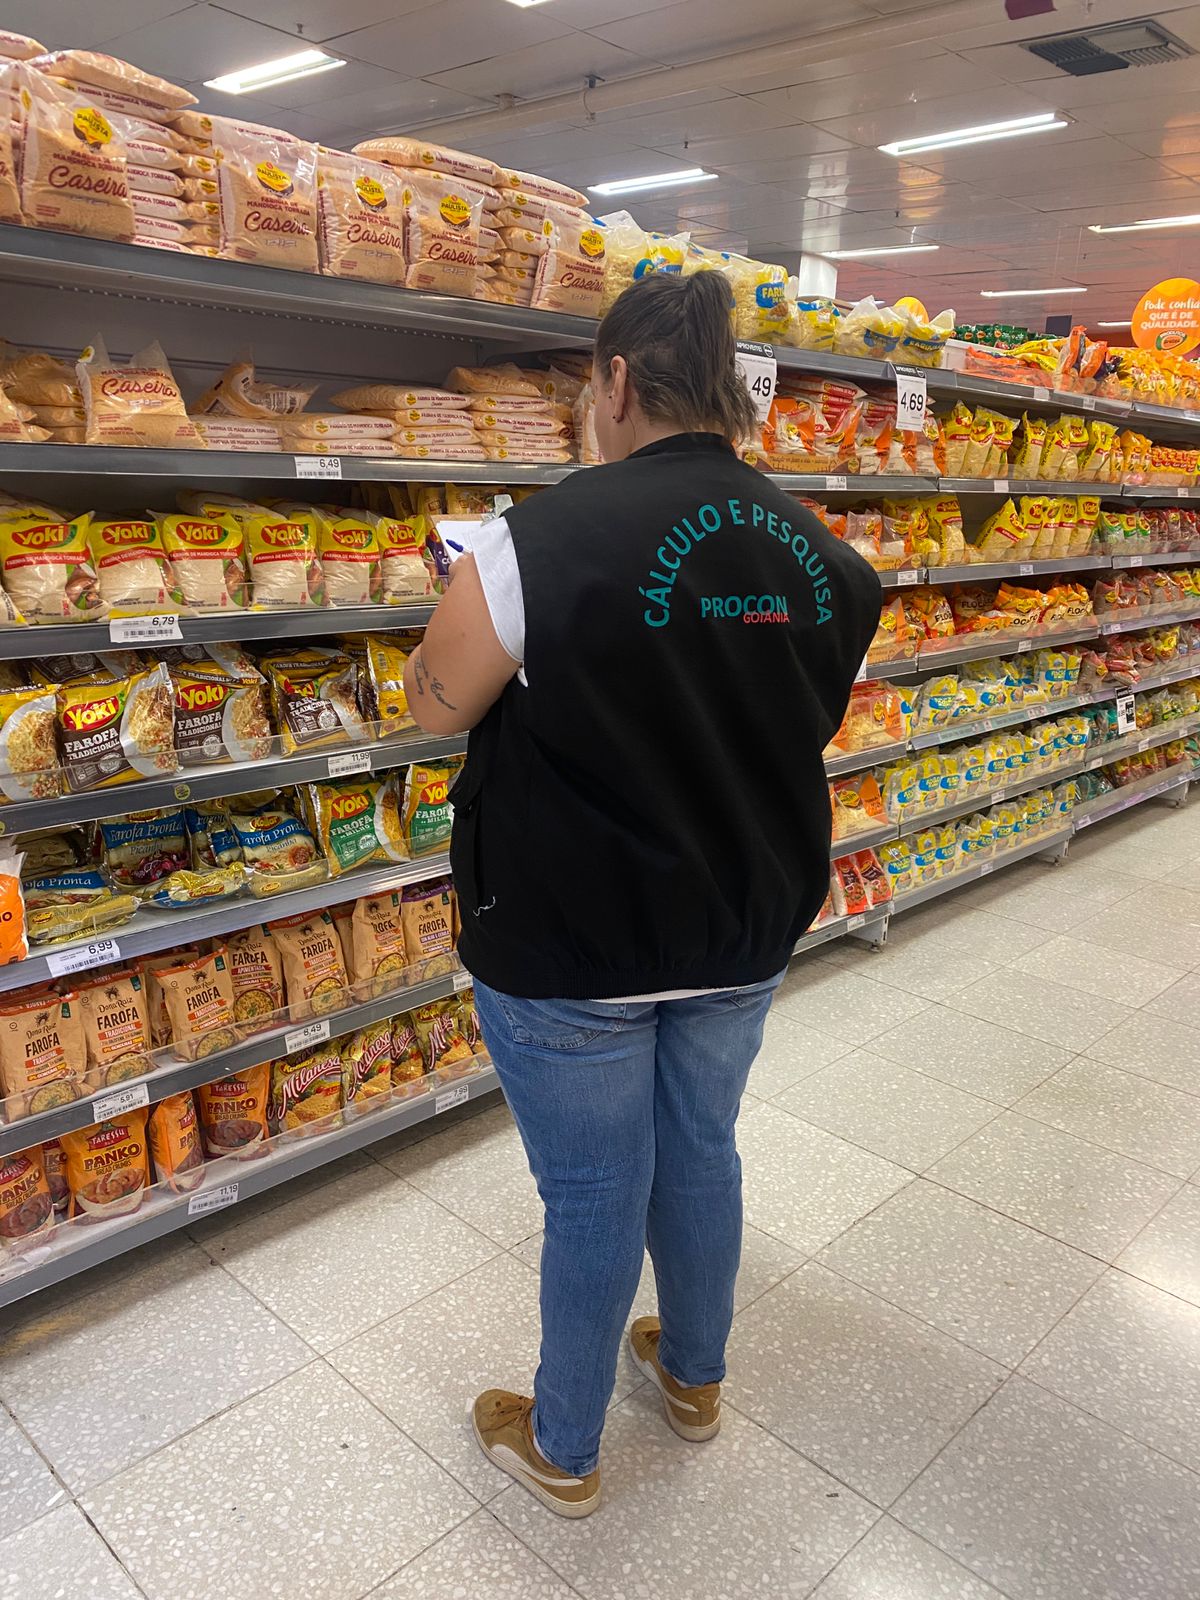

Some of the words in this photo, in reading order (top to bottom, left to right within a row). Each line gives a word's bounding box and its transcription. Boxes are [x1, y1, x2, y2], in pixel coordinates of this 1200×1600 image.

[48, 165, 128, 199] Caseira
[441, 203, 468, 211] PAULISTA
[244, 211, 312, 236] Caseira
[347, 223, 402, 249] Caseira
[1144, 298, 1166, 311] Pode
[1169, 297, 1200, 309] confia
[1149, 312, 1169, 321] QUE
[1180, 311, 1194, 319] DE
[101, 378, 177, 398] Caseira
[900, 391, 924, 413] 4,69
[319, 458, 340, 469] 6,49
[180, 524, 219, 541] Yoki
[638, 503, 722, 628] CÁLCULO
[727, 499, 746, 525] E
[752, 503, 833, 626] PESQUISA
[700, 594, 788, 618] PROCON
[152, 616, 175, 627] 6,79
[180, 684, 224, 710] Yoki
[67, 697, 117, 730] Yoki
[177, 711, 222, 731] FAROFA
[177, 722, 222, 738] TRADICIONAL
[64, 727, 119, 753] FAROFA
[67, 737, 120, 761] TRADICIONAL
[351, 752, 370, 762] 11,99
[332, 794, 369, 818] Yoki
[329, 813, 373, 836] FAROFA
[110, 828, 144, 843] Farofa
[244, 832, 271, 845] arofa
[48, 877, 92, 887] Pronta
[372, 919, 397, 934] ROFA
[418, 917, 448, 934] FAROFA
[88, 940, 113, 955] 6,99
[301, 937, 334, 960] FAROFA
[232, 951, 269, 967] FAROFA
[186, 986, 221, 1012] FAROFA
[97, 1006, 140, 1031] FAROFA
[303, 1023, 322, 1036] 8,49
[25, 1031, 61, 1058] FAROFA
[277, 1056, 341, 1120] Milanesa
[120, 1093, 134, 1104] 5,91
[207, 1097, 257, 1115] PANKO
[92, 1127, 126, 1145] TARESSU
[83, 1143, 142, 1172] PANKO
[96, 1166, 113, 1176] BREAD
[2, 1167, 41, 1201] ANKO
[219, 1184, 239, 1196] 11,19
